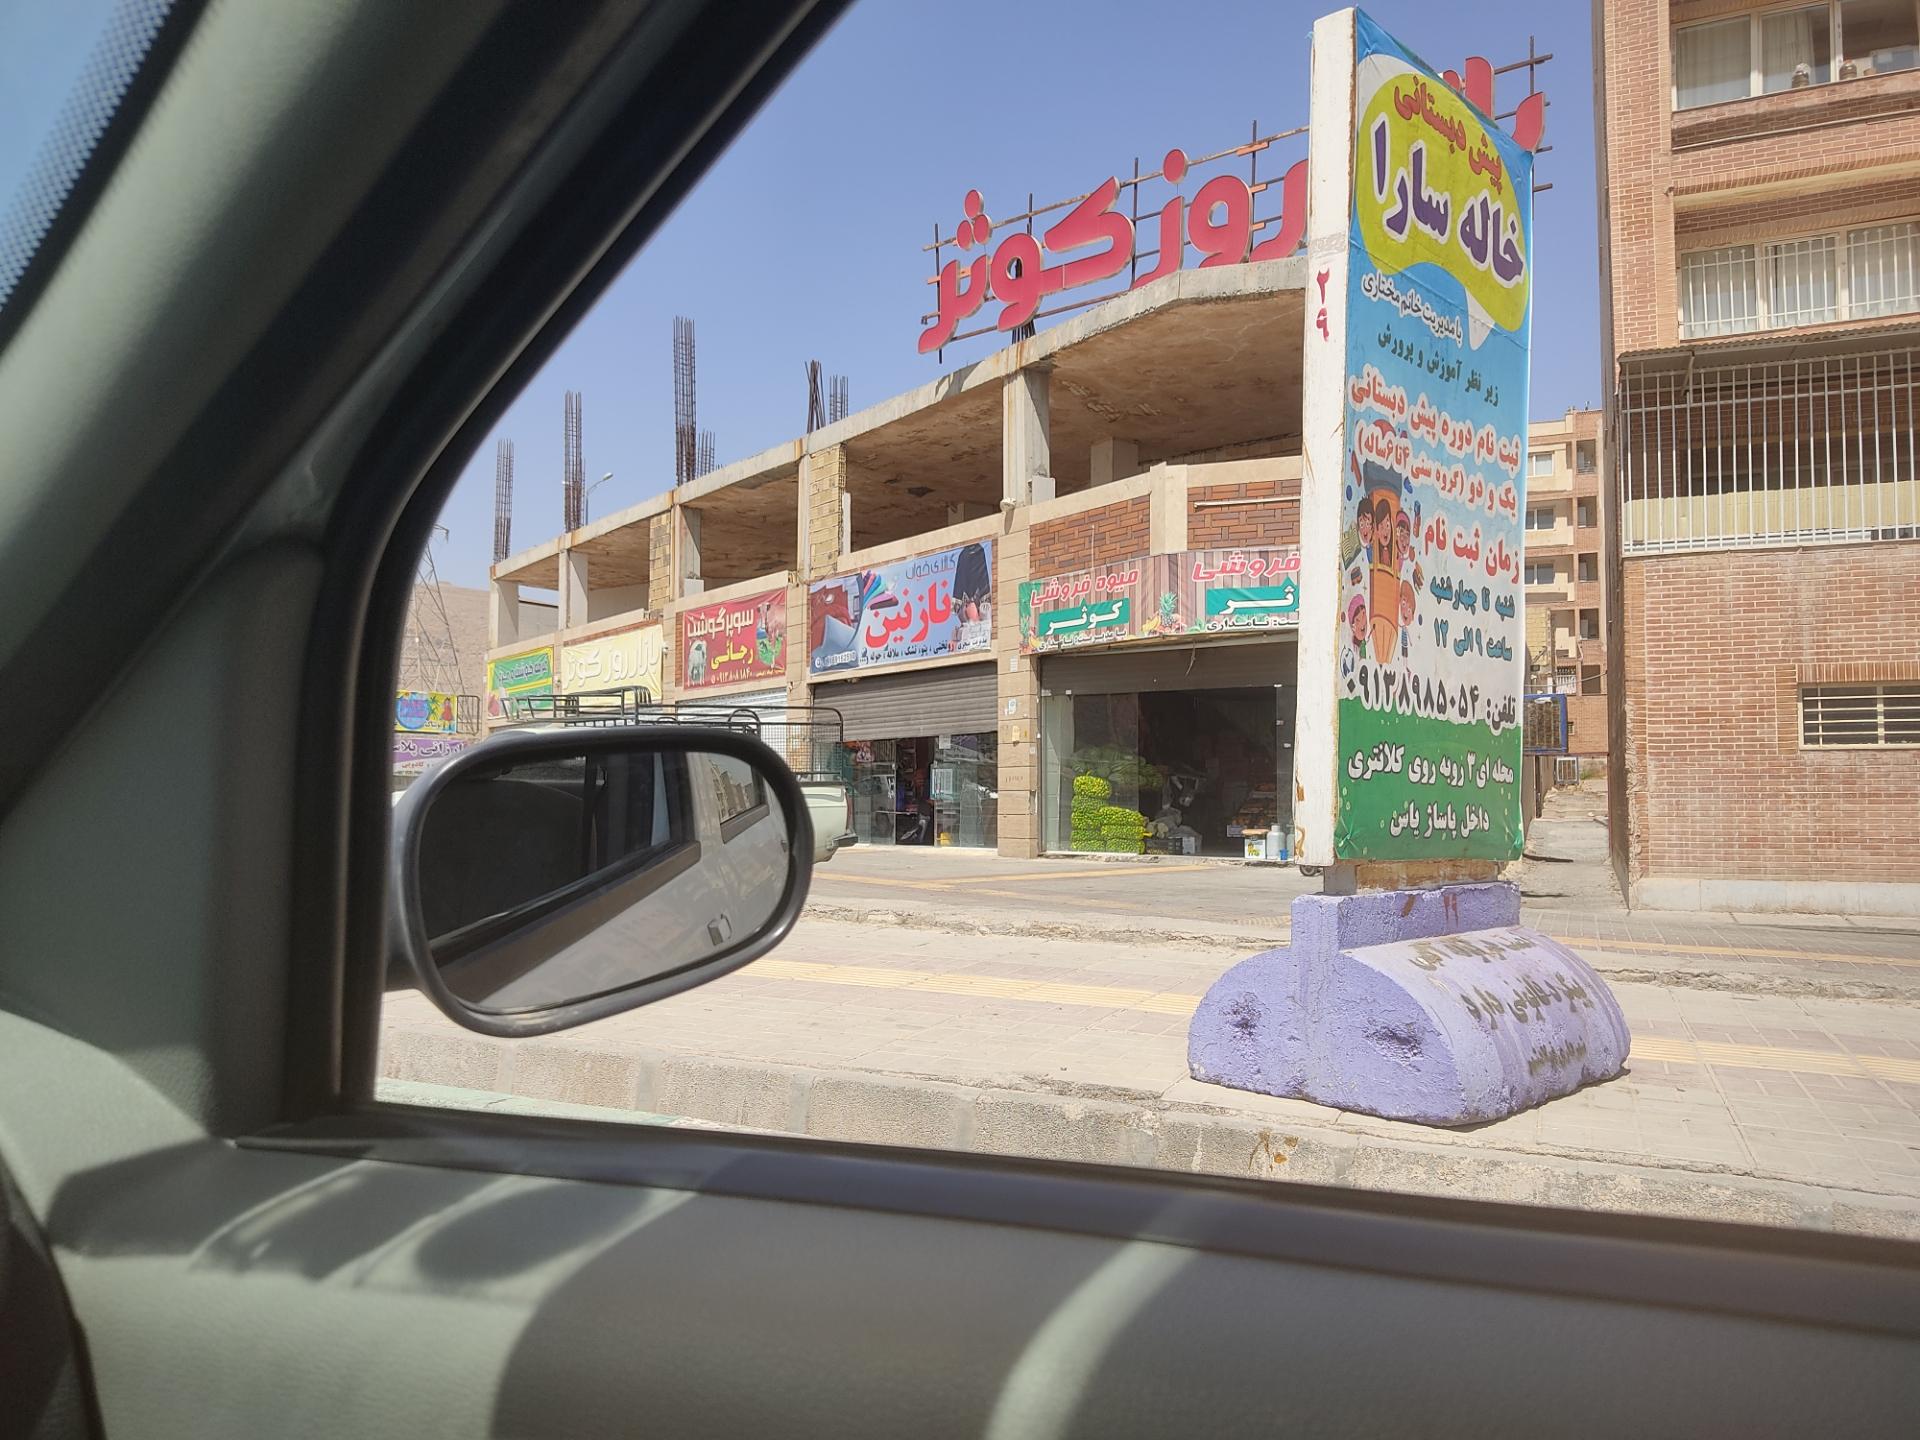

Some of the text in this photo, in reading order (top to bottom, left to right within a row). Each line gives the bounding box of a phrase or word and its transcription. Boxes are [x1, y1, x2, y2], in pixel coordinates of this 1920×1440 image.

[1394, 75, 1467, 153] دبستانی
[1469, 134, 1503, 194] پیش
[1374, 119, 1524, 282] خاله سارا
[918, 175, 1136, 355] کوثر
[1363, 271, 1400, 304] مختاری
[1401, 291, 1422, 316] خانم
[1378, 323, 1498, 406] زیر نظر آموزش و پرورش
[1352, 370, 1519, 472] ثبت نام دوره پیش دبستانی
[1411, 457, 1432, 479] سنی
[1468, 479, 1482, 503] دو
[1425, 517, 1519, 584] زمان ثبت نام
[1030, 569, 1139, 608] میوه فروشی
[1481, 586, 1490, 611] تا
[865, 580, 952, 649] نازنین
[1046, 600, 1122, 635] کوثر
[1433, 617, 1449, 648] ۱۲
[1486, 635, 1513, 662] ساعت
[1348, 741, 1405, 781] کلانتری
[1424, 801, 1457, 838] پاساژ
[1460, 803, 1489, 838] داخل
